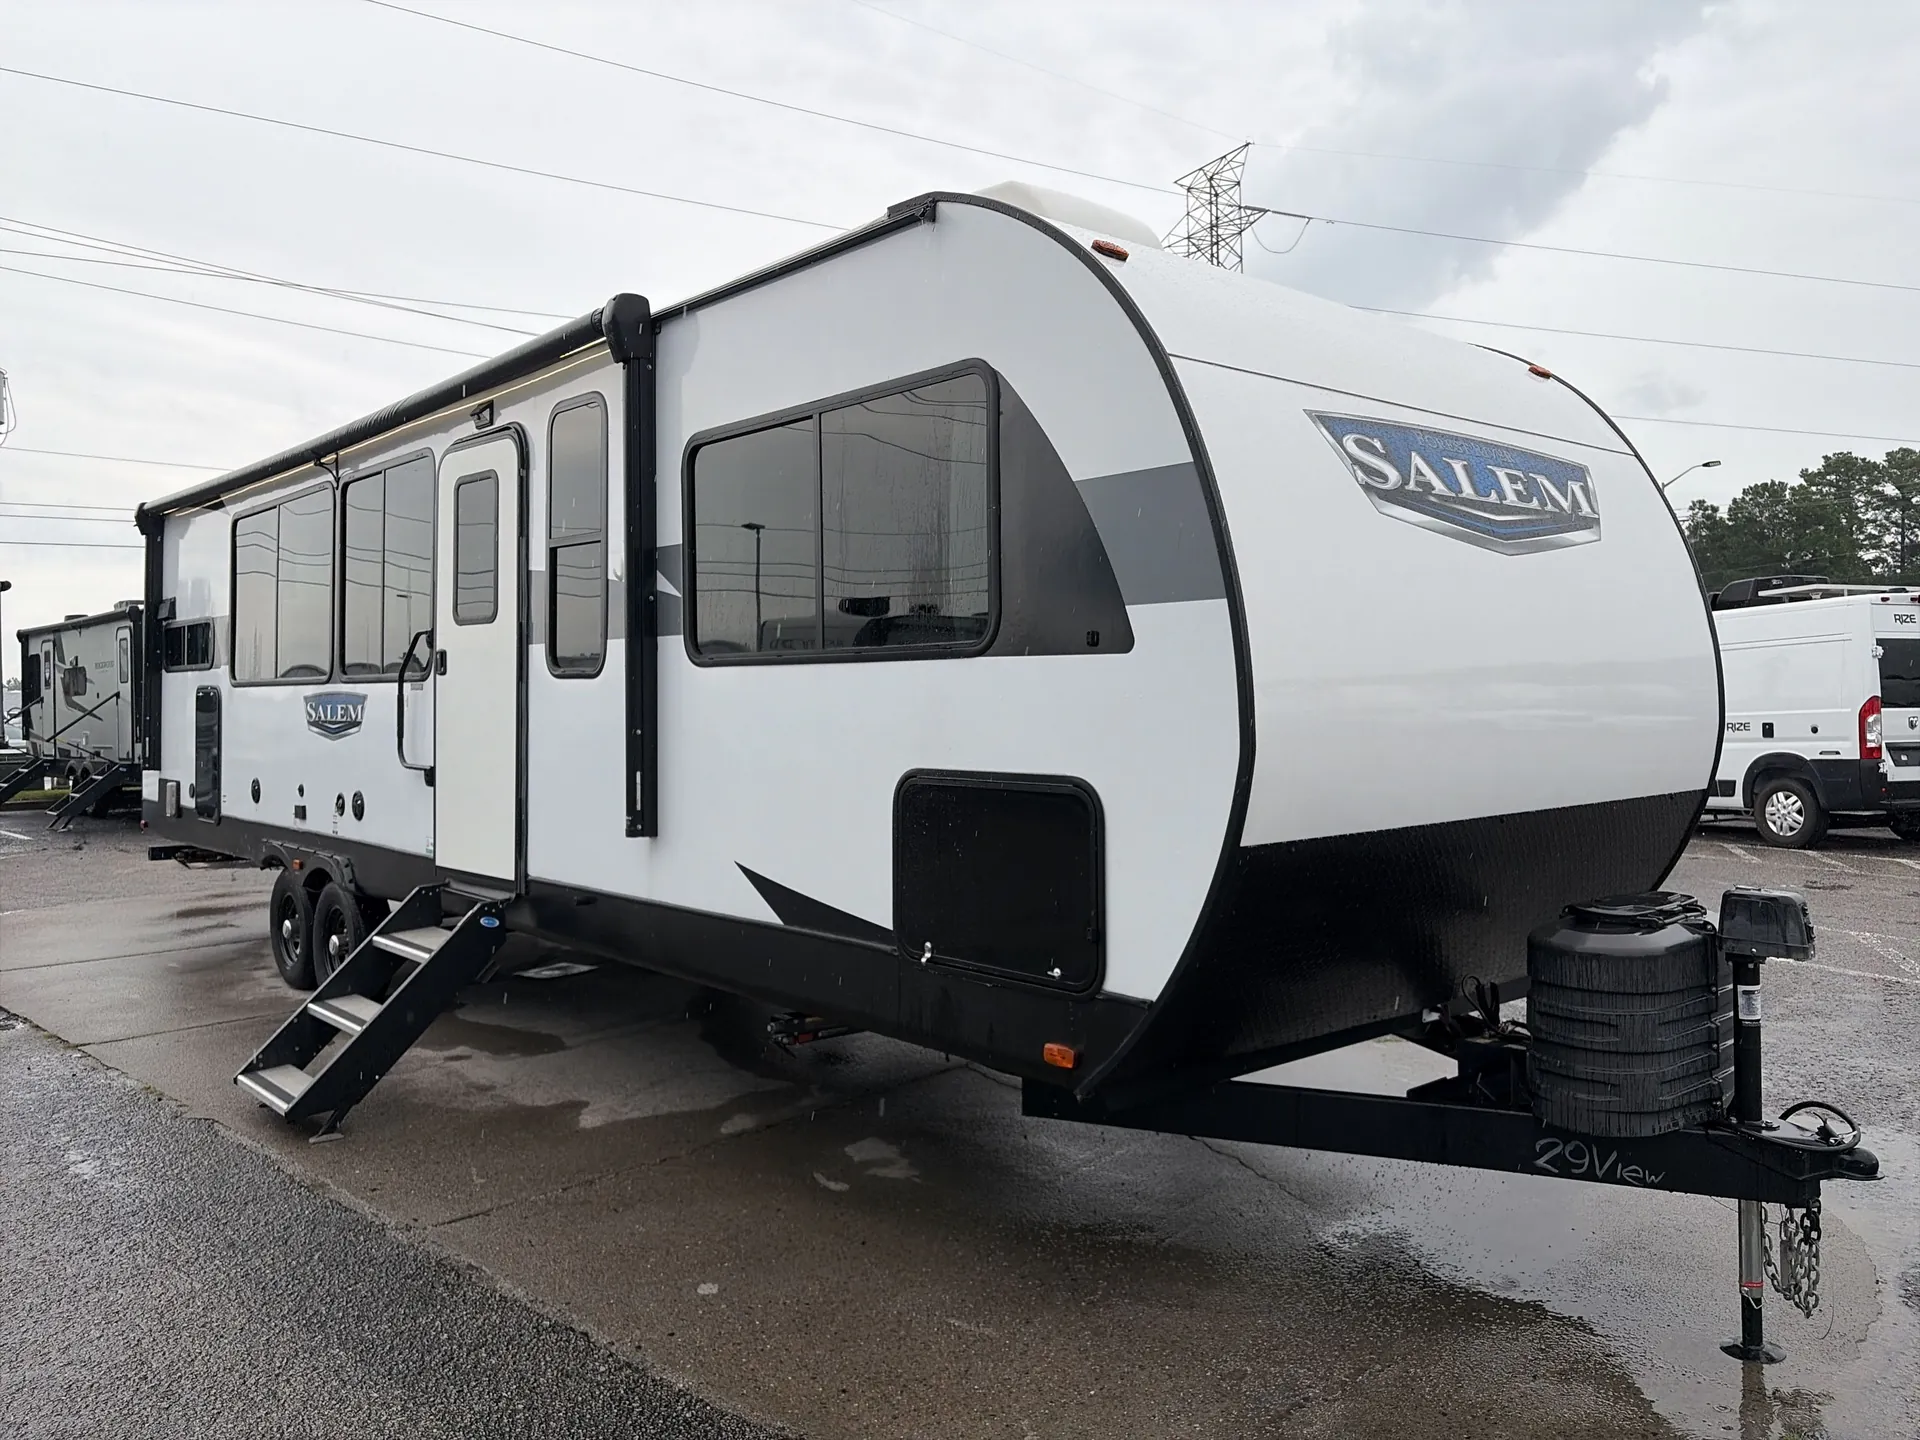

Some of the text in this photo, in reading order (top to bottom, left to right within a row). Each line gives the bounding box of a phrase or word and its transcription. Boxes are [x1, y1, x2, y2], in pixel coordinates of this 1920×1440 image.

[1342, 433, 1600, 519] SALEM
[1893, 613, 1917, 625] RIZE
[306, 701, 364, 722] SALEM
[1726, 721, 1751, 733] RIZE
